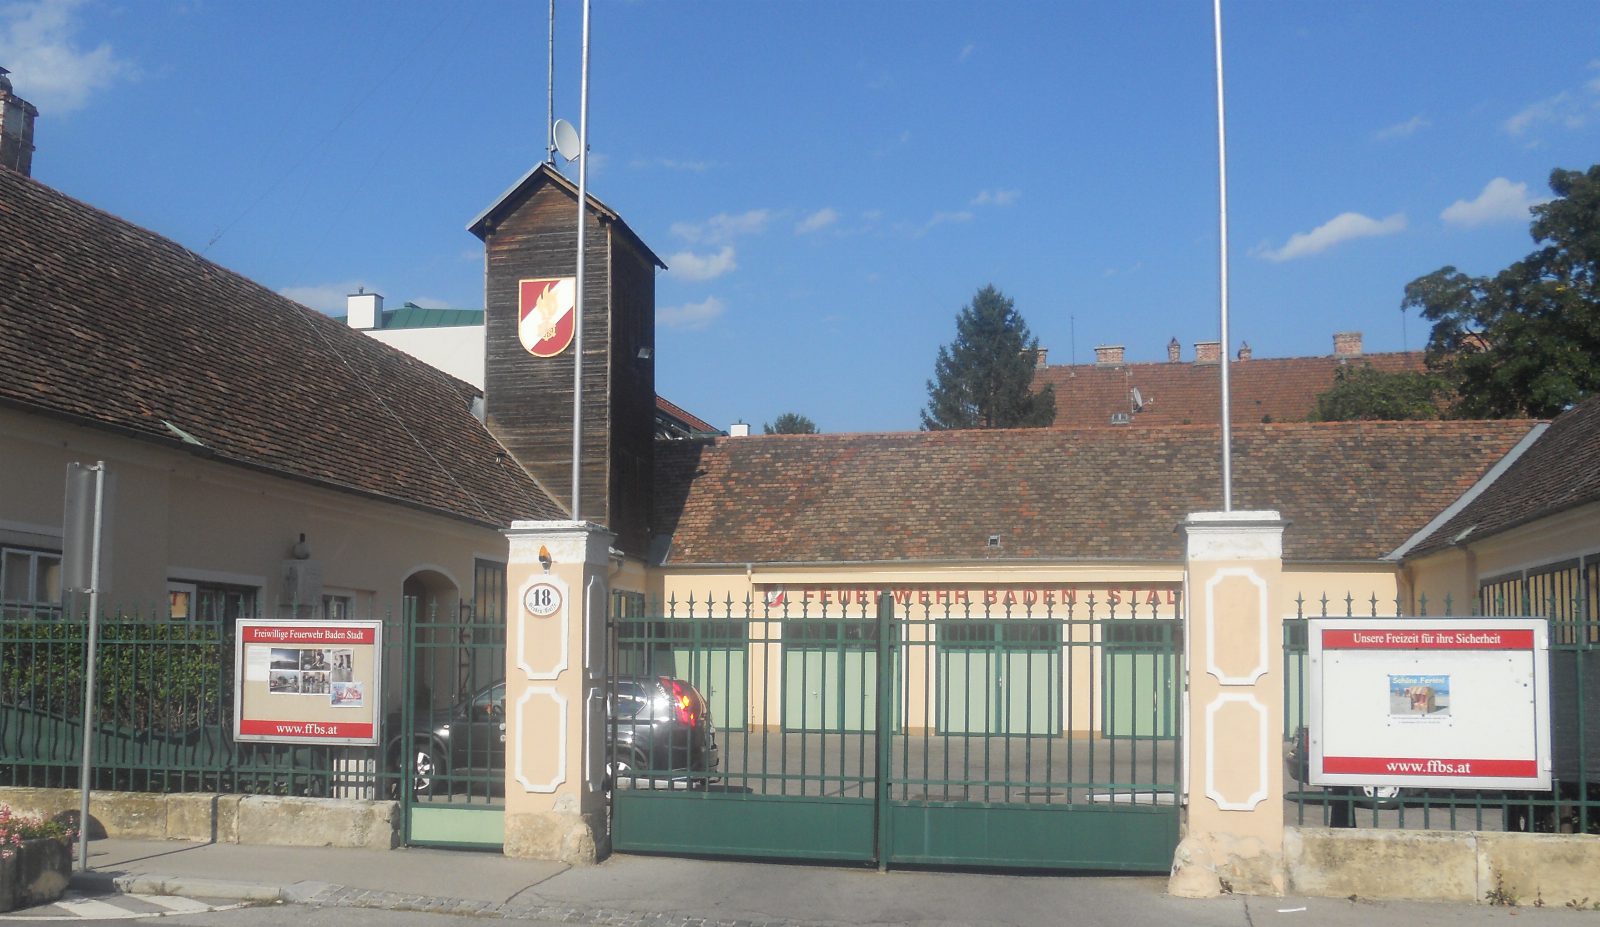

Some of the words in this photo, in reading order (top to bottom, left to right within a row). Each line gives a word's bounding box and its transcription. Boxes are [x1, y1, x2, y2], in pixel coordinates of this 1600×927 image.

[533, 588, 552, 607] 18
[983, 587, 1077, 605] BADEN
[254, 629, 289, 641] Freiwillige
[289, 629, 323, 640] Feuerwehr
[325, 630, 345, 640] Baden
[346, 630, 364, 640] Stadt
[1353, 633, 1384, 644] Unsere
[1386, 633, 1419, 644] Freizeit
[1421, 633, 1434, 644] für
[1436, 633, 1453, 644] ihre
[1455, 633, 1501, 644] Sicherheit
[276, 723, 338, 735] www.ffbs.at
[1386, 760, 1471, 773] www.ffbs.at
